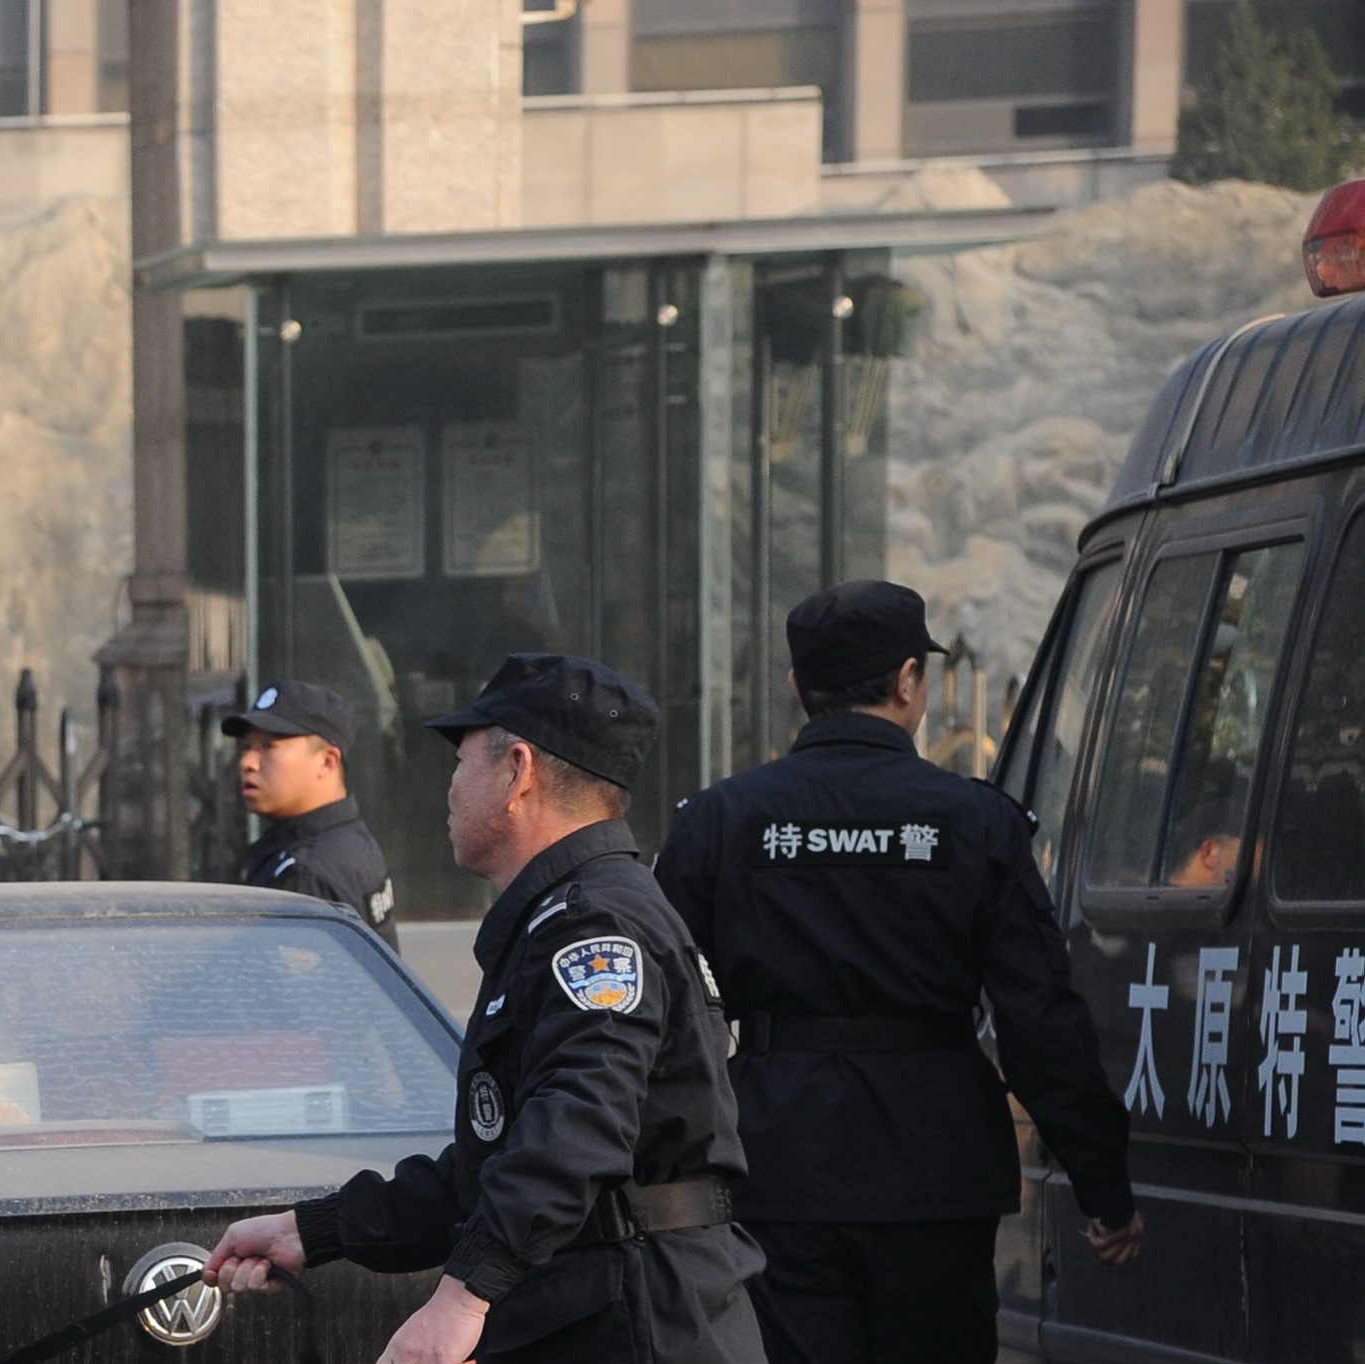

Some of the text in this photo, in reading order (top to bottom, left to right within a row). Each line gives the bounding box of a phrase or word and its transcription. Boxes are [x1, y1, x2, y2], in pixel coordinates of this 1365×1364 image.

[763, 823, 940, 861] 特 SWAT 警
